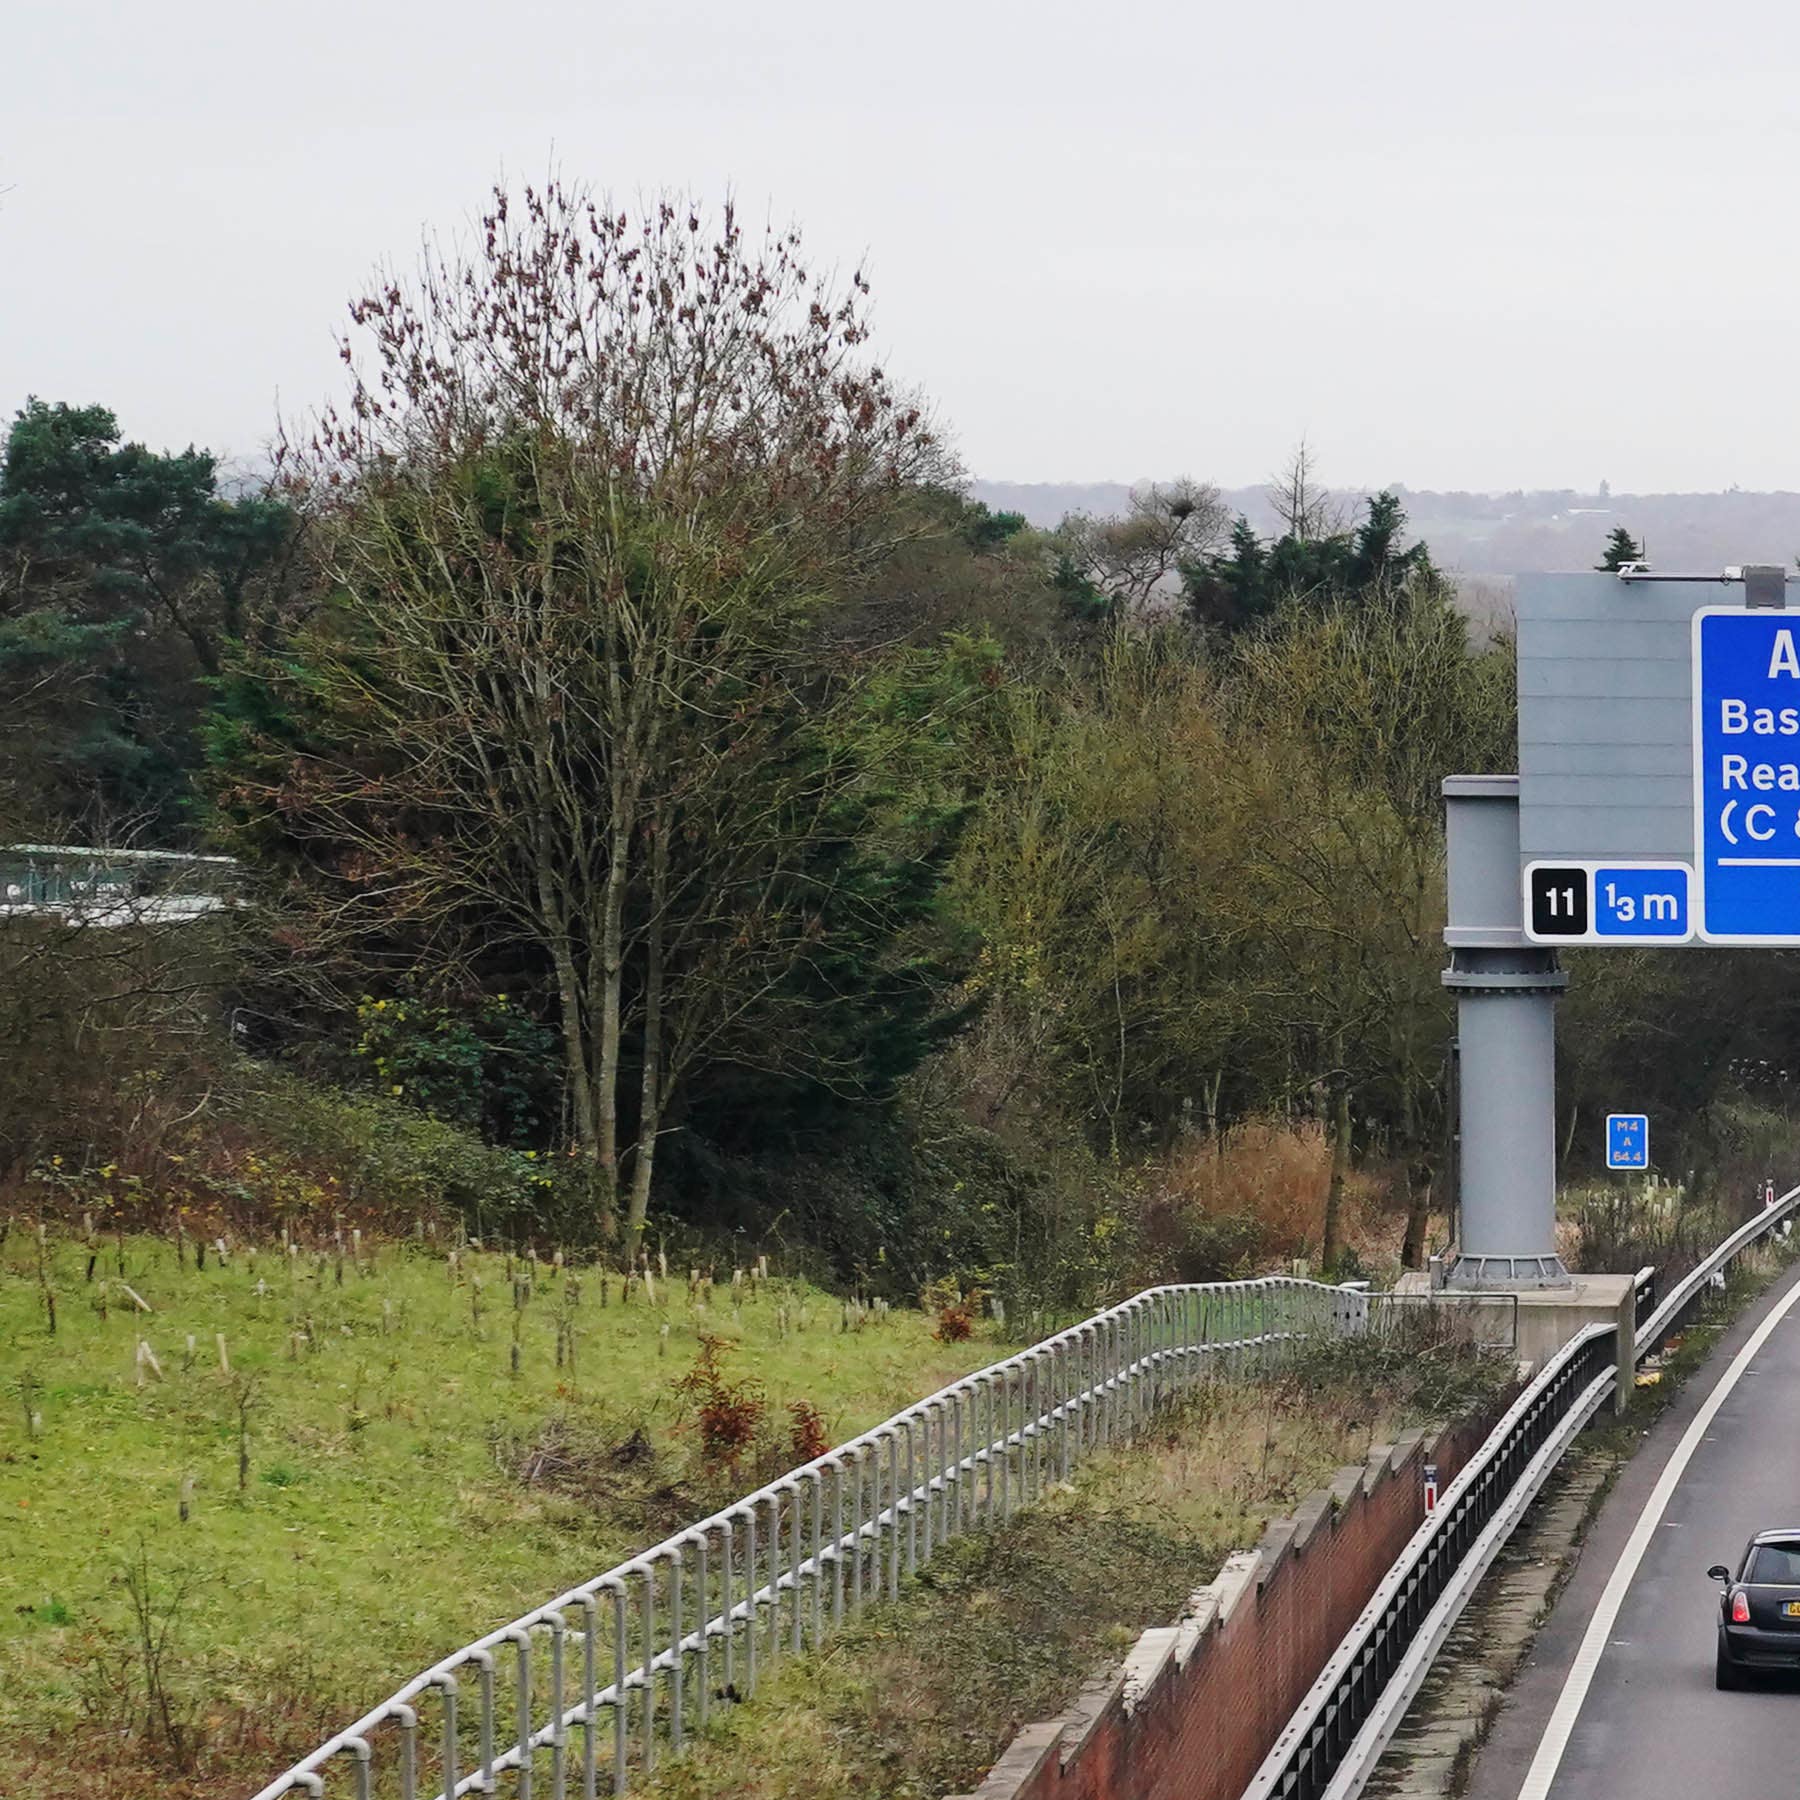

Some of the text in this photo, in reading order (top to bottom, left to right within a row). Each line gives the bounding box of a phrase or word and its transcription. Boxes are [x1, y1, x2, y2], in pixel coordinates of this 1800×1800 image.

[1546, 888, 1574, 916] 11
[1617, 1121, 1638, 1132] M4
[1624, 1136, 1632, 1146] A
